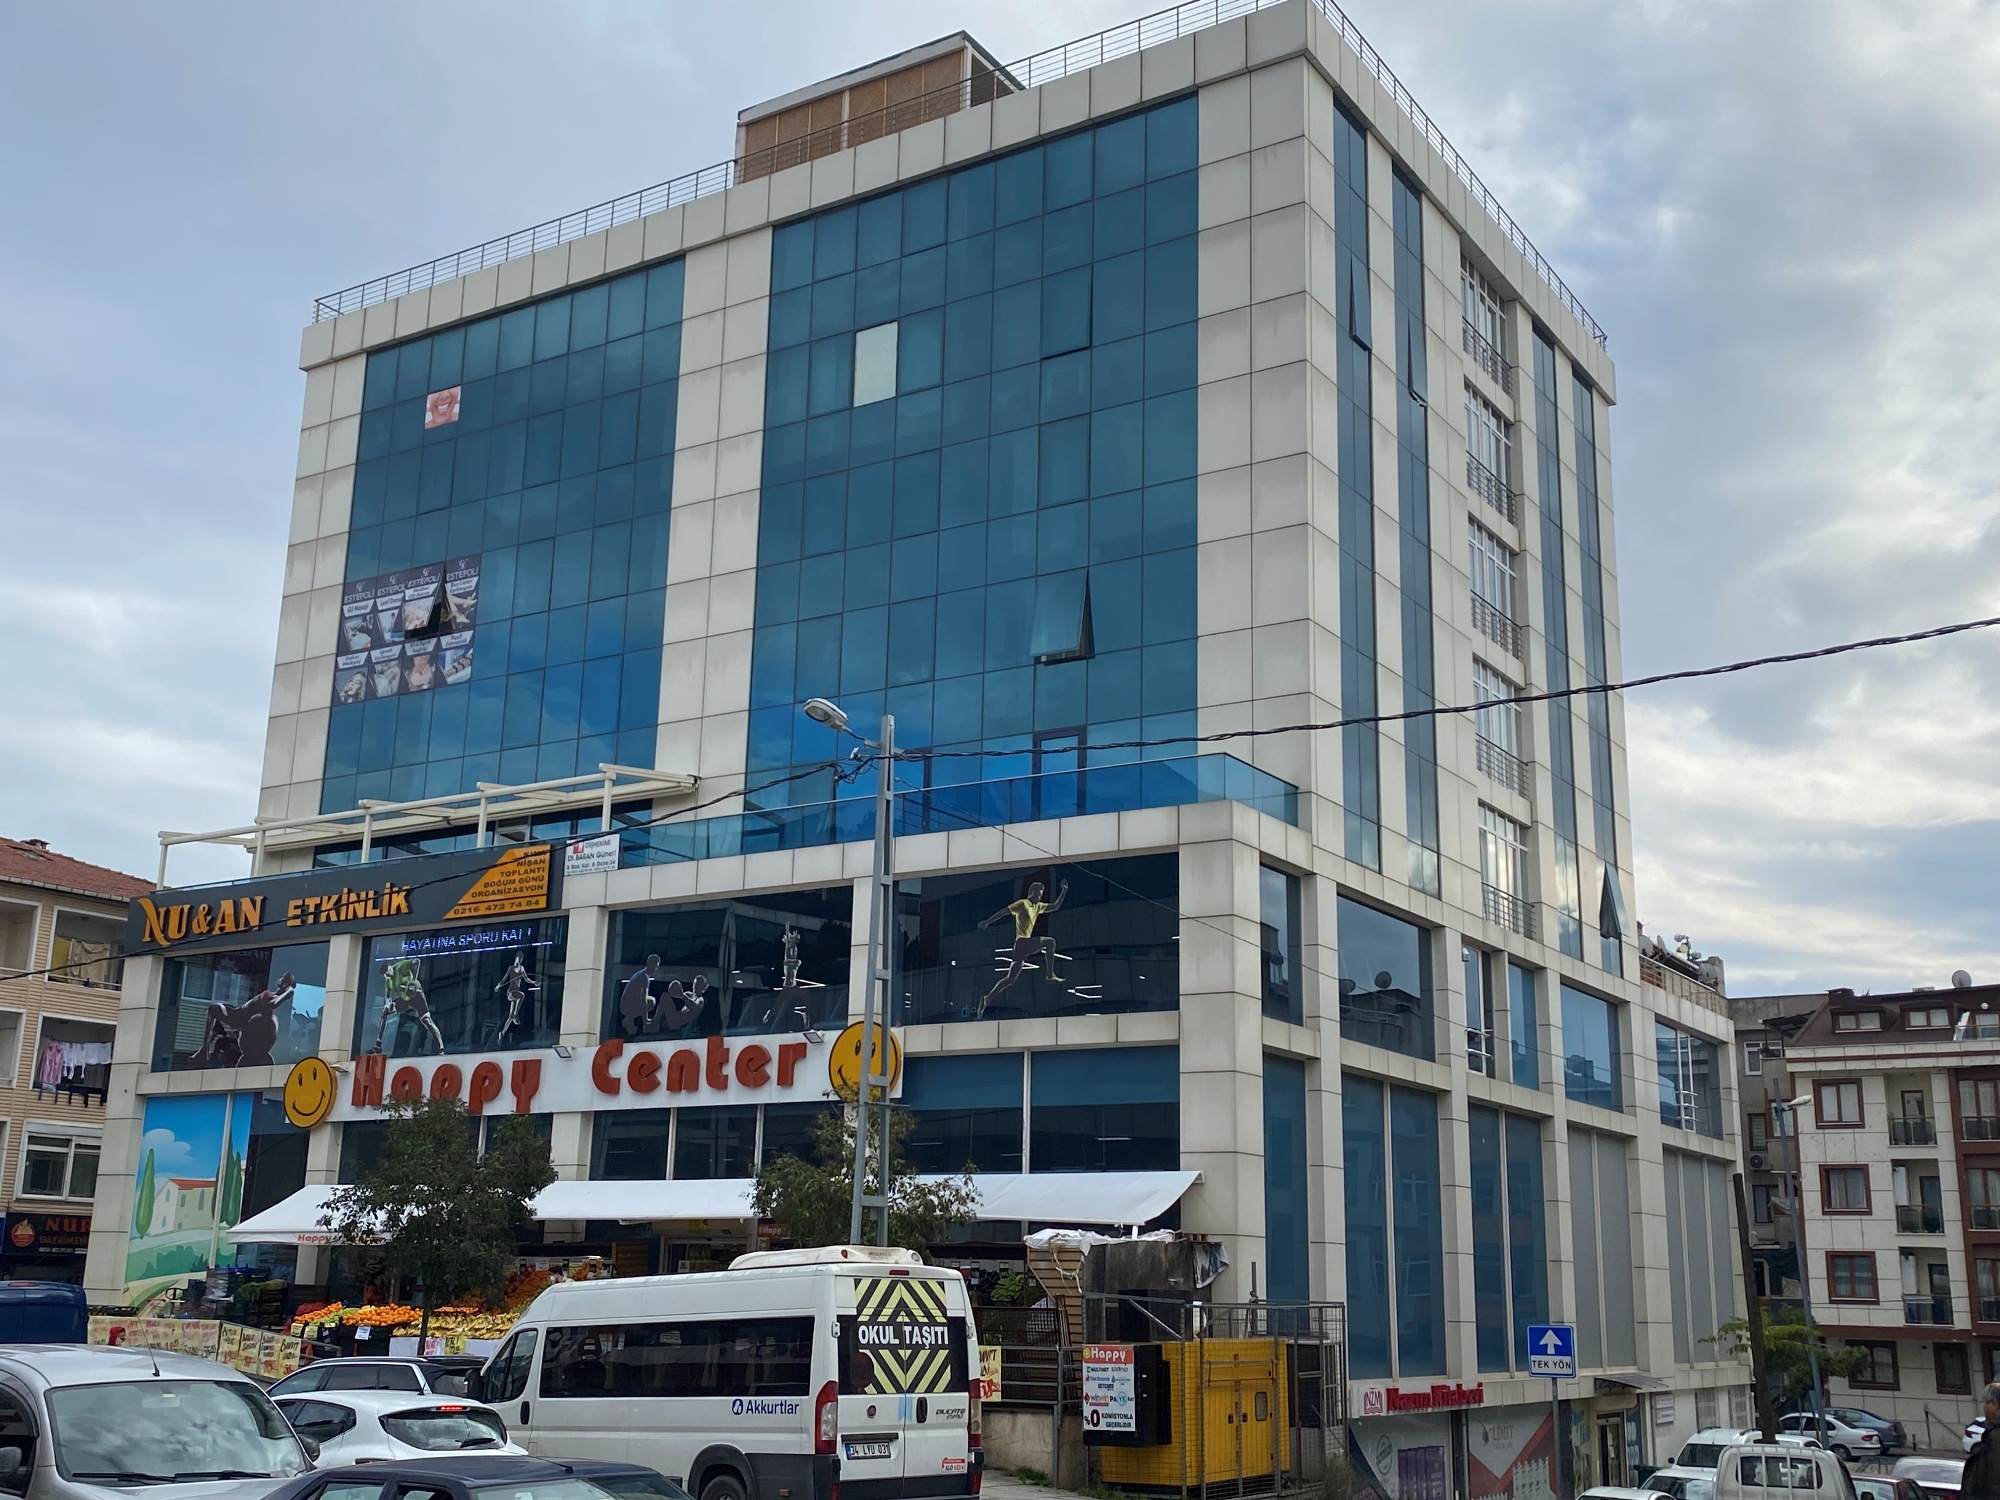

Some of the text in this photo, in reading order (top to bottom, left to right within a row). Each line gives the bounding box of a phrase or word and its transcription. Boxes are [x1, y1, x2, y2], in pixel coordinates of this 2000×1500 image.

[517, 858, 546, 868] NİŞAN
[576, 852, 595, 861] BARAN
[500, 868, 545, 878] TOPLANTI
[483, 875, 545, 889] DOĞUM GÜNÜ
[471, 884, 544, 898] ORGANİZASYON
[287, 882, 412, 927] ETKİNLİK
[453, 907, 480, 915] 0216
[509, 901, 523, 909] 74
[351, 1036, 808, 1116] Happy Center
[297, 1233, 332, 1244] Happy
[858, 1325, 949, 1349] OKUL TAŞITI
[1091, 1347, 1127, 1363] Happy
[1532, 1359, 1571, 1370] TEK YÖN
[746, 1400, 800, 1415] Akkurtlar
[850, 1445, 859, 1456] 34
